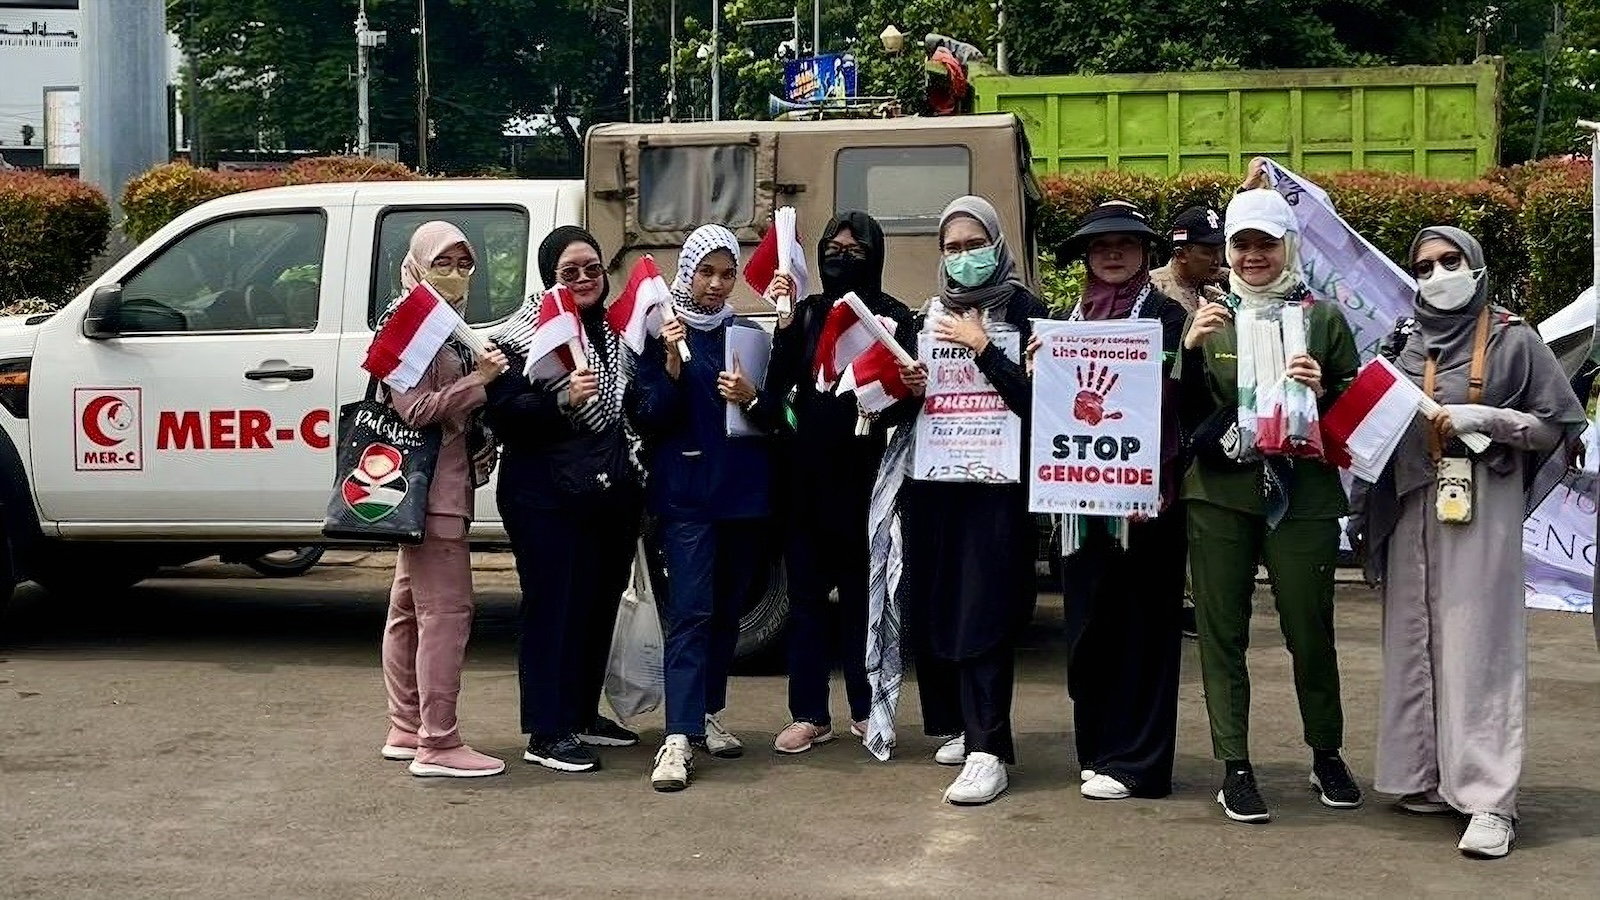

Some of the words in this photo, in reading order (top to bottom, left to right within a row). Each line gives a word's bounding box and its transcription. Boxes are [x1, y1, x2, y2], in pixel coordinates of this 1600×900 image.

[1053, 347, 1077, 358] the
[1081, 348, 1148, 361] Genocide
[156, 409, 331, 450] MER-C
[1052, 434, 1141, 461] STOP
[84, 452, 136, 465] MER-C
[1037, 465, 1153, 485] GENOCIDE
